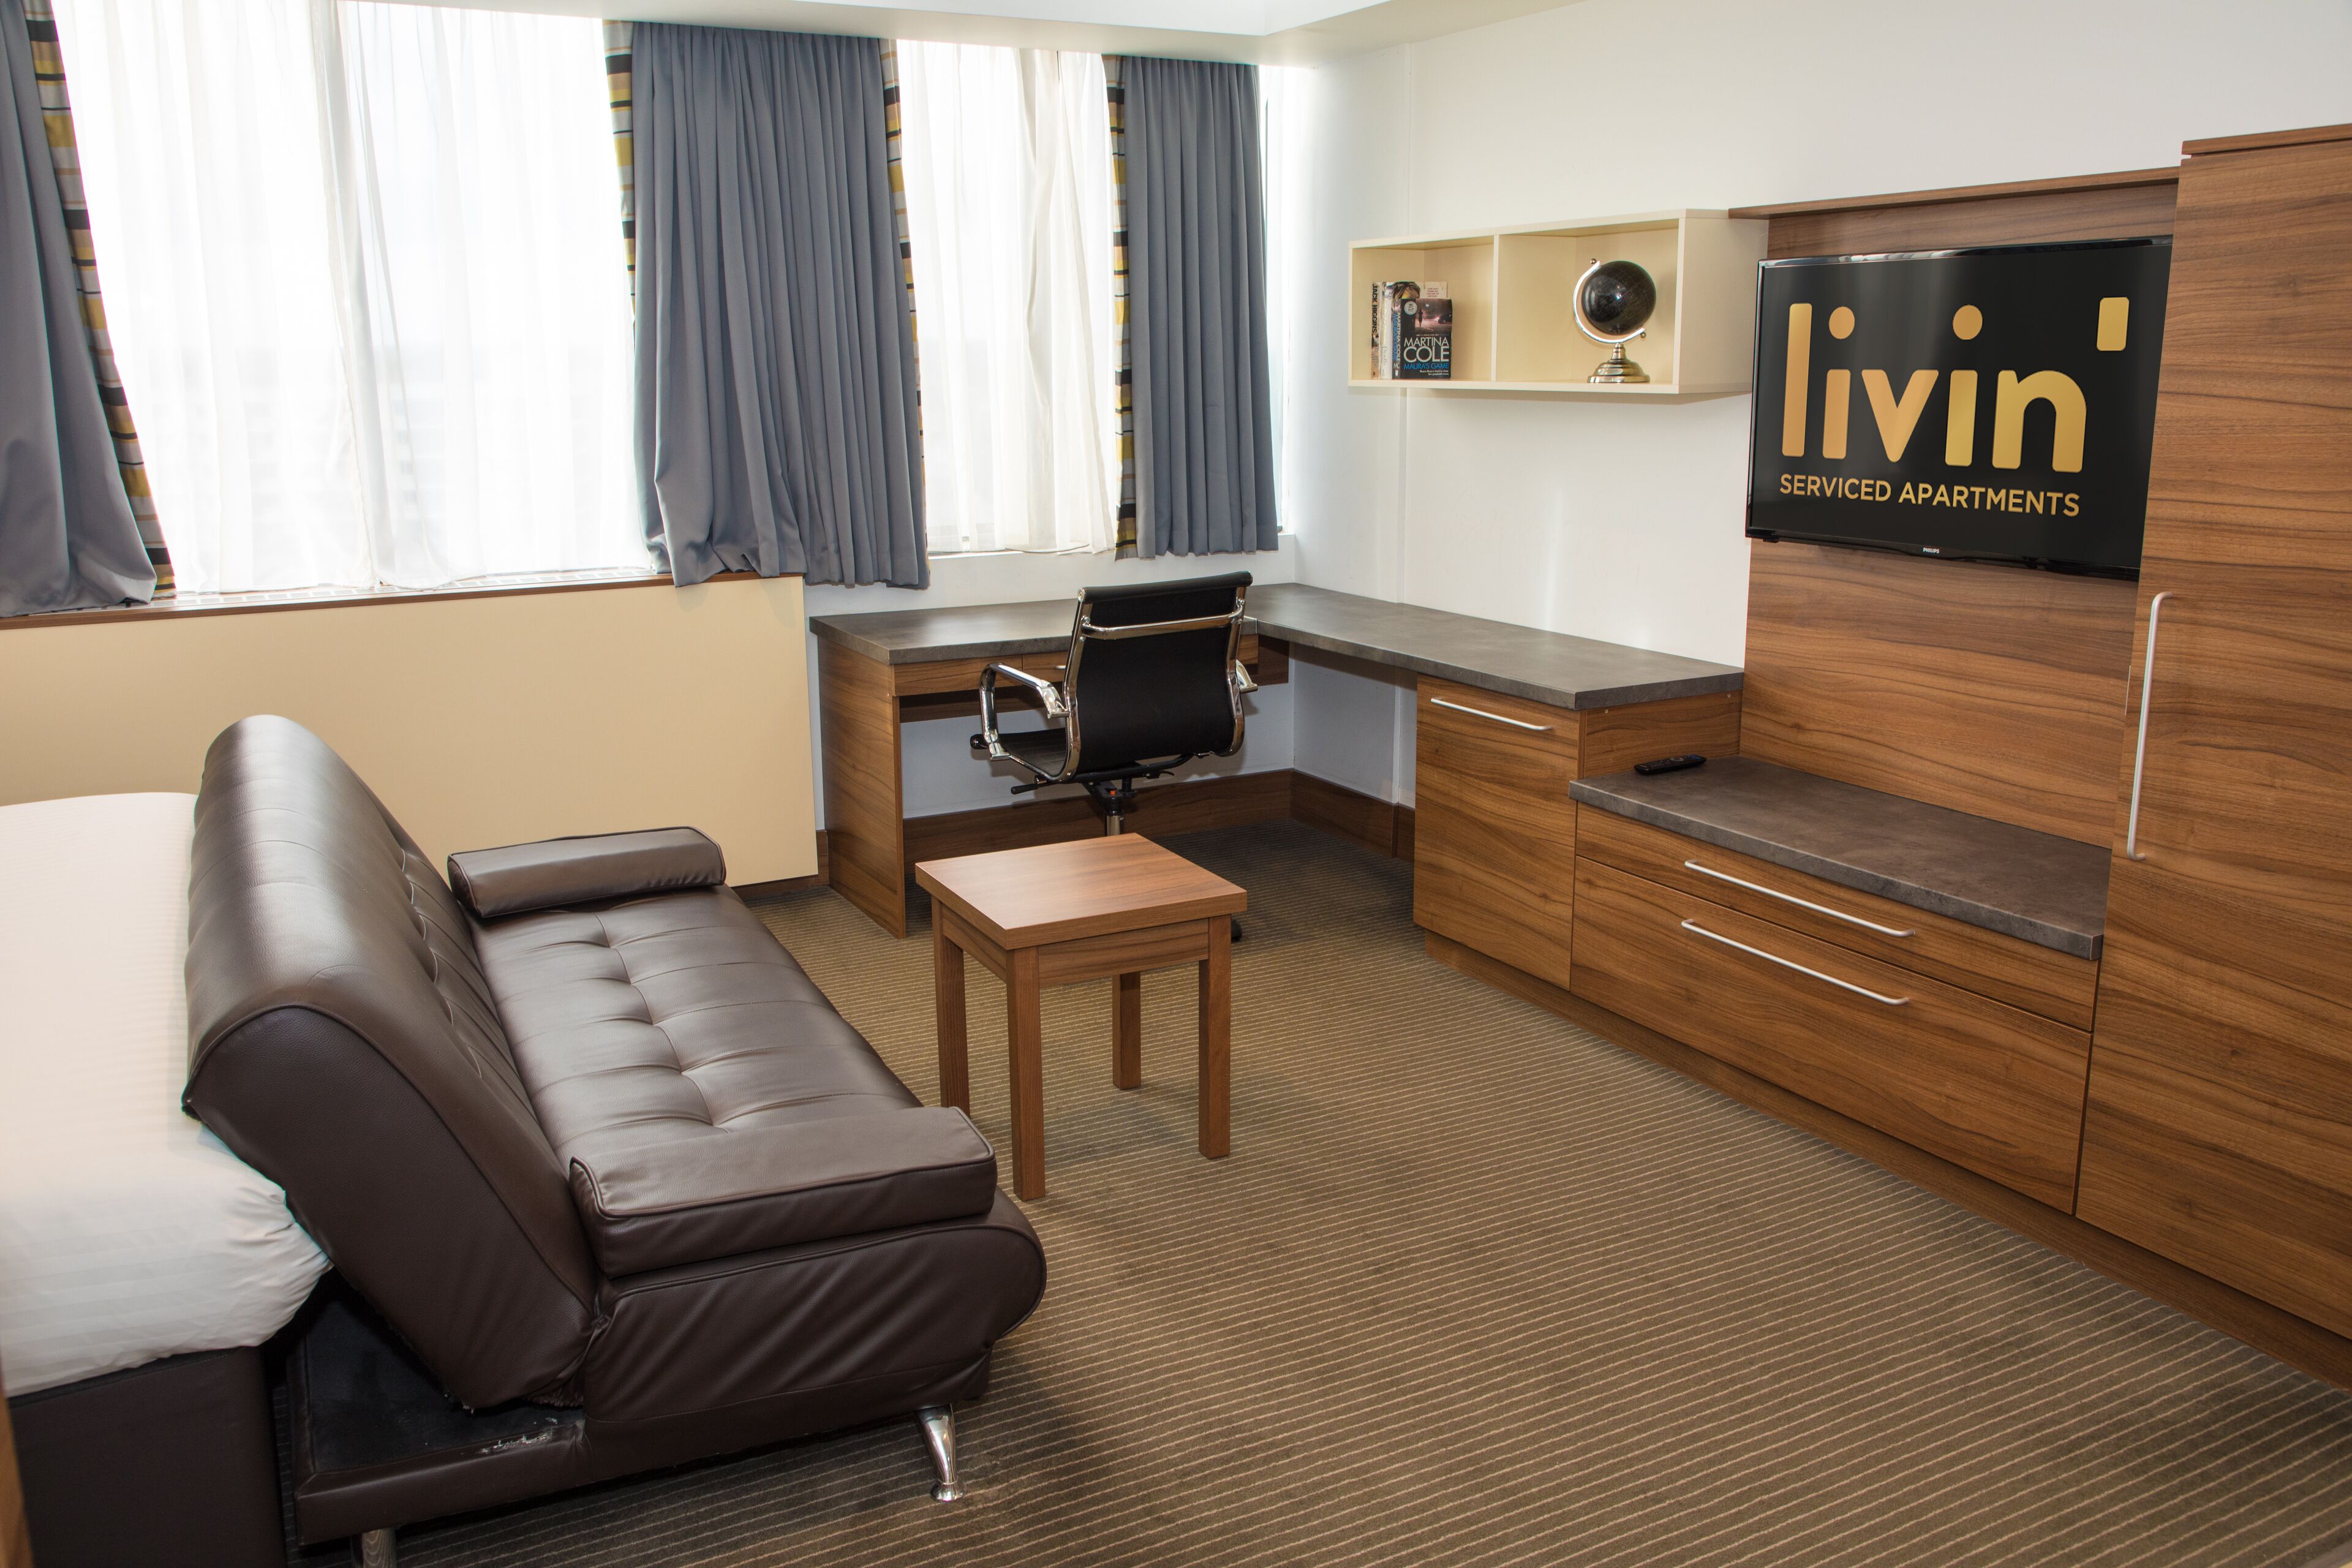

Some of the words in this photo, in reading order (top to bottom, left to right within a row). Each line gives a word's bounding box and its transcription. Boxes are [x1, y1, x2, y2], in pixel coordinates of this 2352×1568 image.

[1403, 337, 1449, 347] MARTINA
[1403, 346, 1449, 363] COLE
[1782, 297, 2130, 473] livin'
[1779, 473, 1891, 502] SERVICED
[1898, 482, 2080, 517] APARTMENTS
